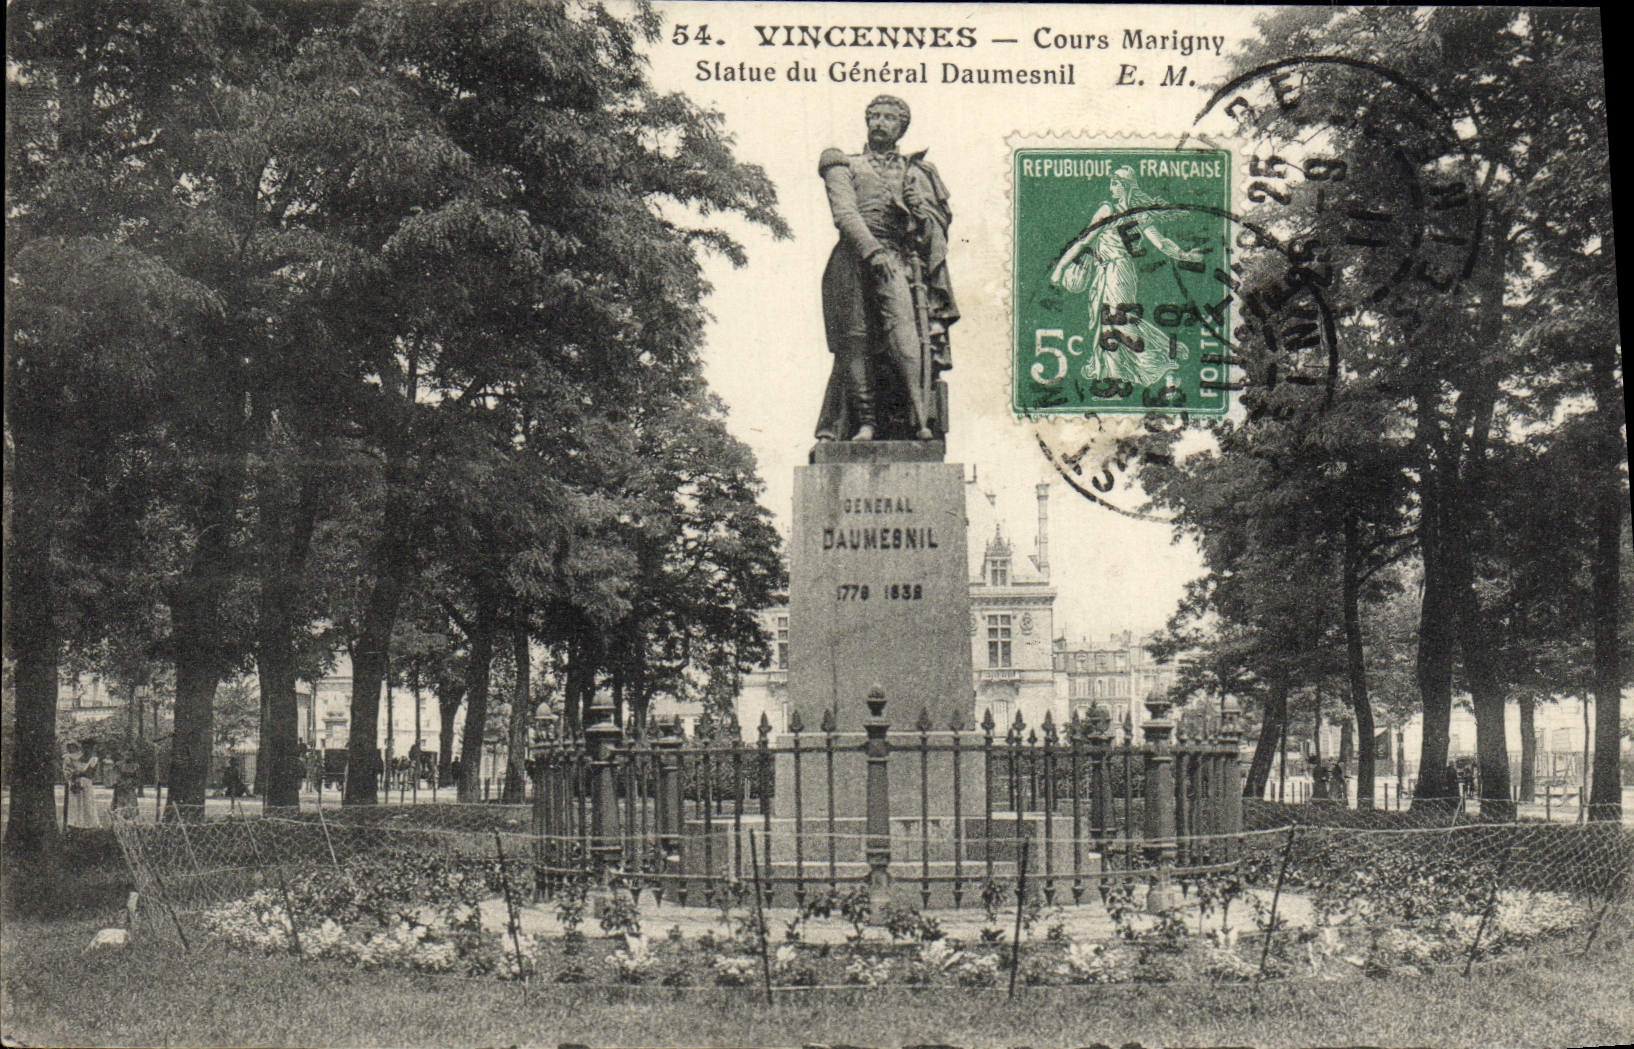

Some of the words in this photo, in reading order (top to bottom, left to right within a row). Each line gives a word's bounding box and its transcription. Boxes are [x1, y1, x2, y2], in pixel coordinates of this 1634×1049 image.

[1140, 158, 1221, 179] FRANÇAISE
[844, 498, 913, 514] GENERAL
[823, 527, 939, 551] DAUMESNIL
